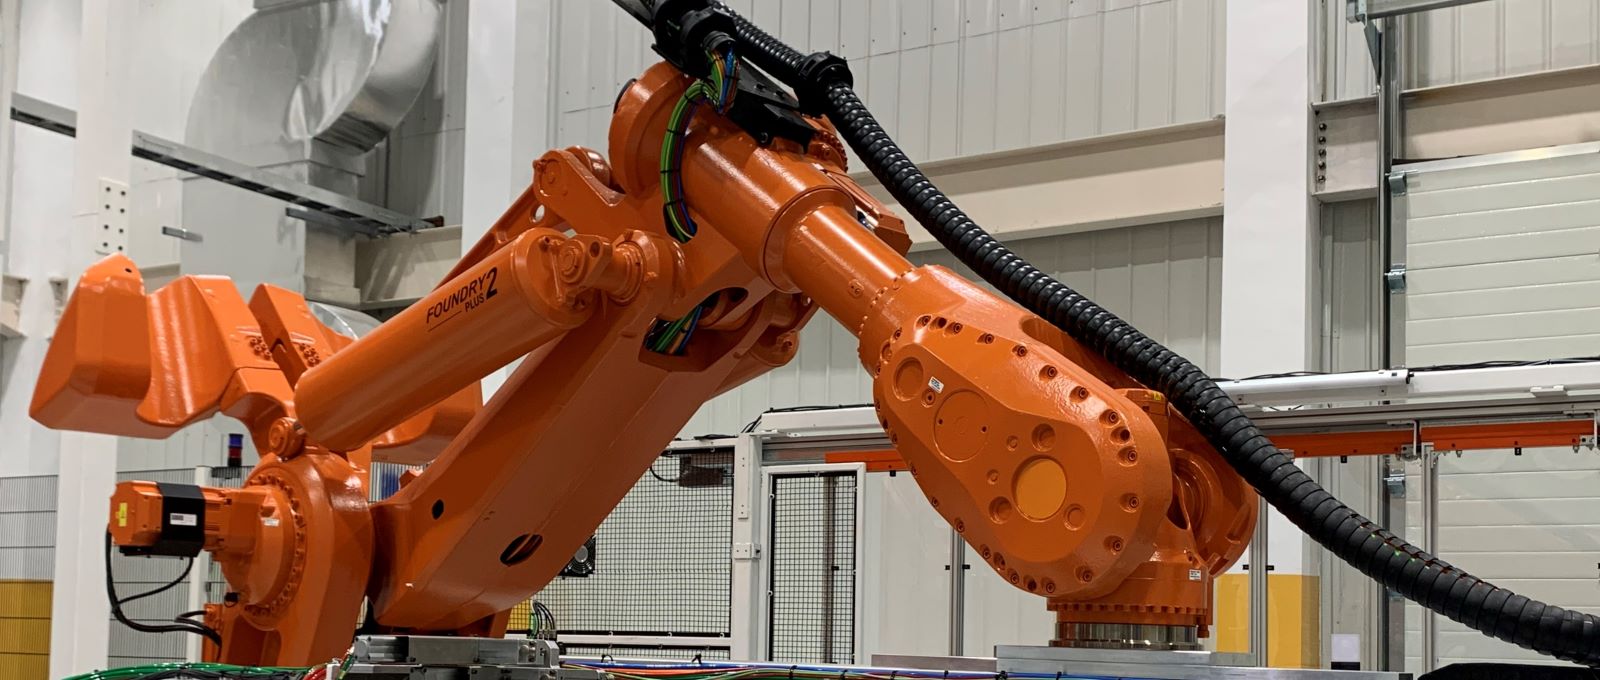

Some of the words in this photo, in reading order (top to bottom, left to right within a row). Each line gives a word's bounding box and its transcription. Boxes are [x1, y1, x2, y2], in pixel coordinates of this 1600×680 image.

[426, 273, 486, 324] FOUNDRY
[486, 267, 497, 300] 2
[465, 293, 484, 312] PLUS
